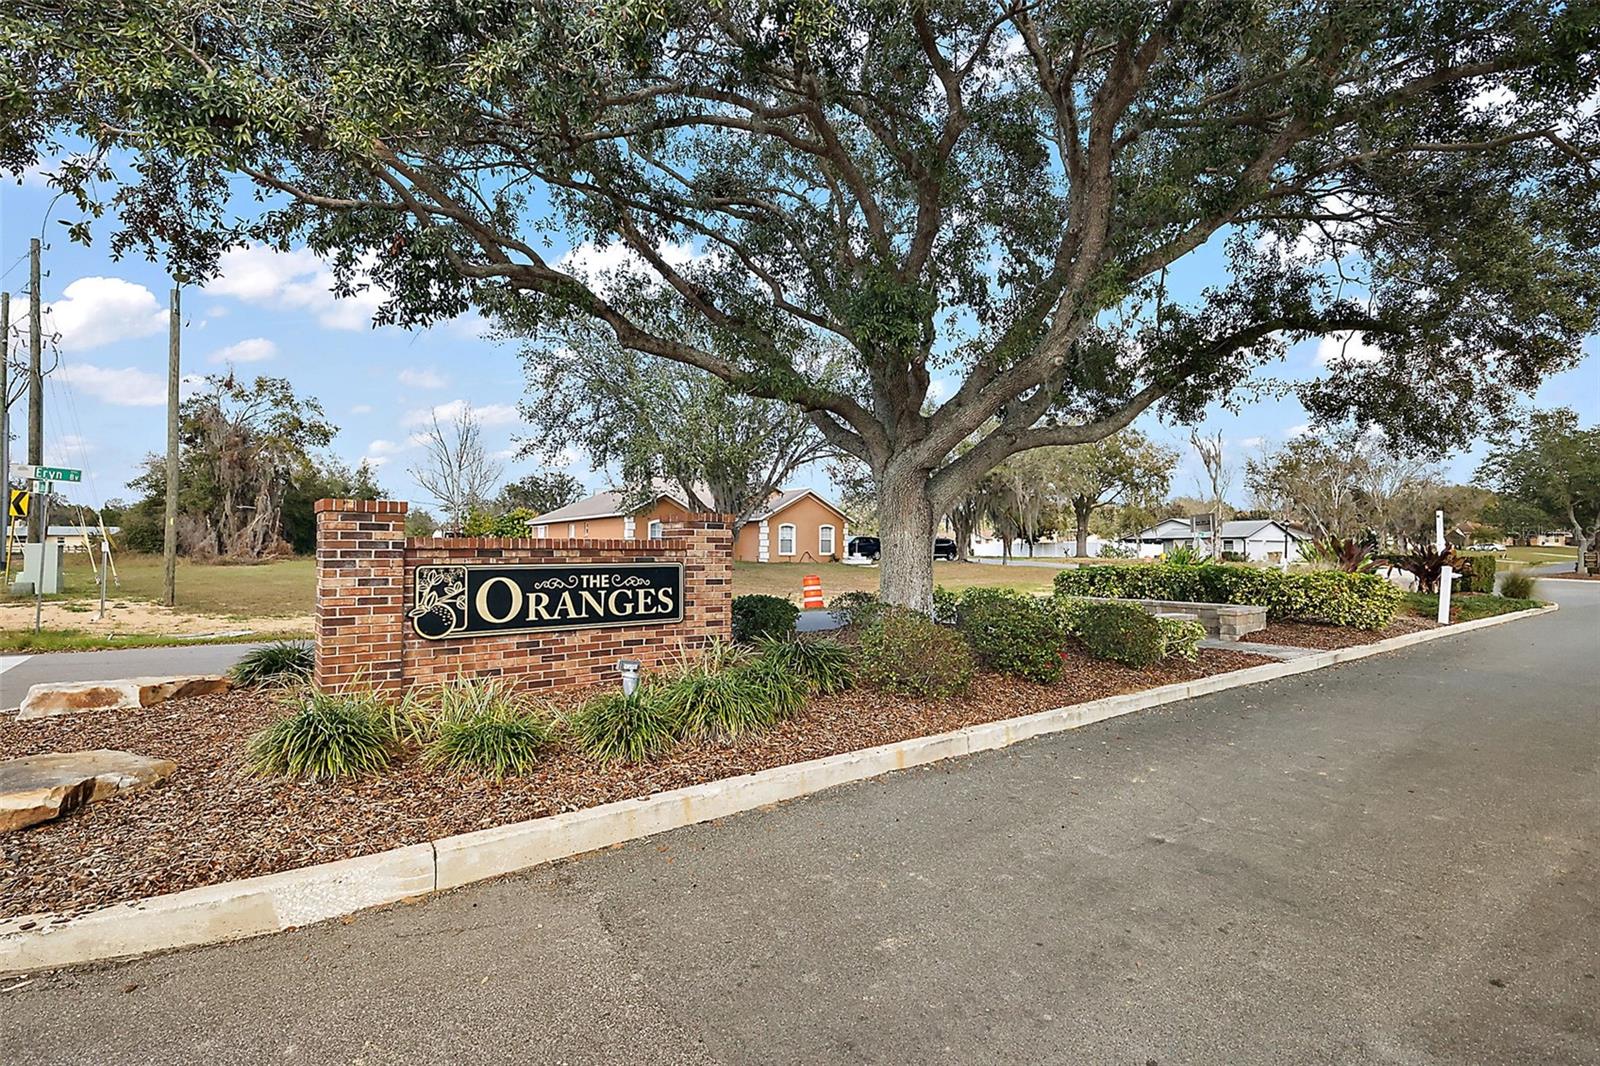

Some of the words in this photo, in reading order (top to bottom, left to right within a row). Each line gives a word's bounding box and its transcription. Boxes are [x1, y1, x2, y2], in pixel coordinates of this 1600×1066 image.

[36, 467, 63, 480] Eryn
[580, 574, 610, 588] THE
[475, 576, 674, 624] ORANGES
